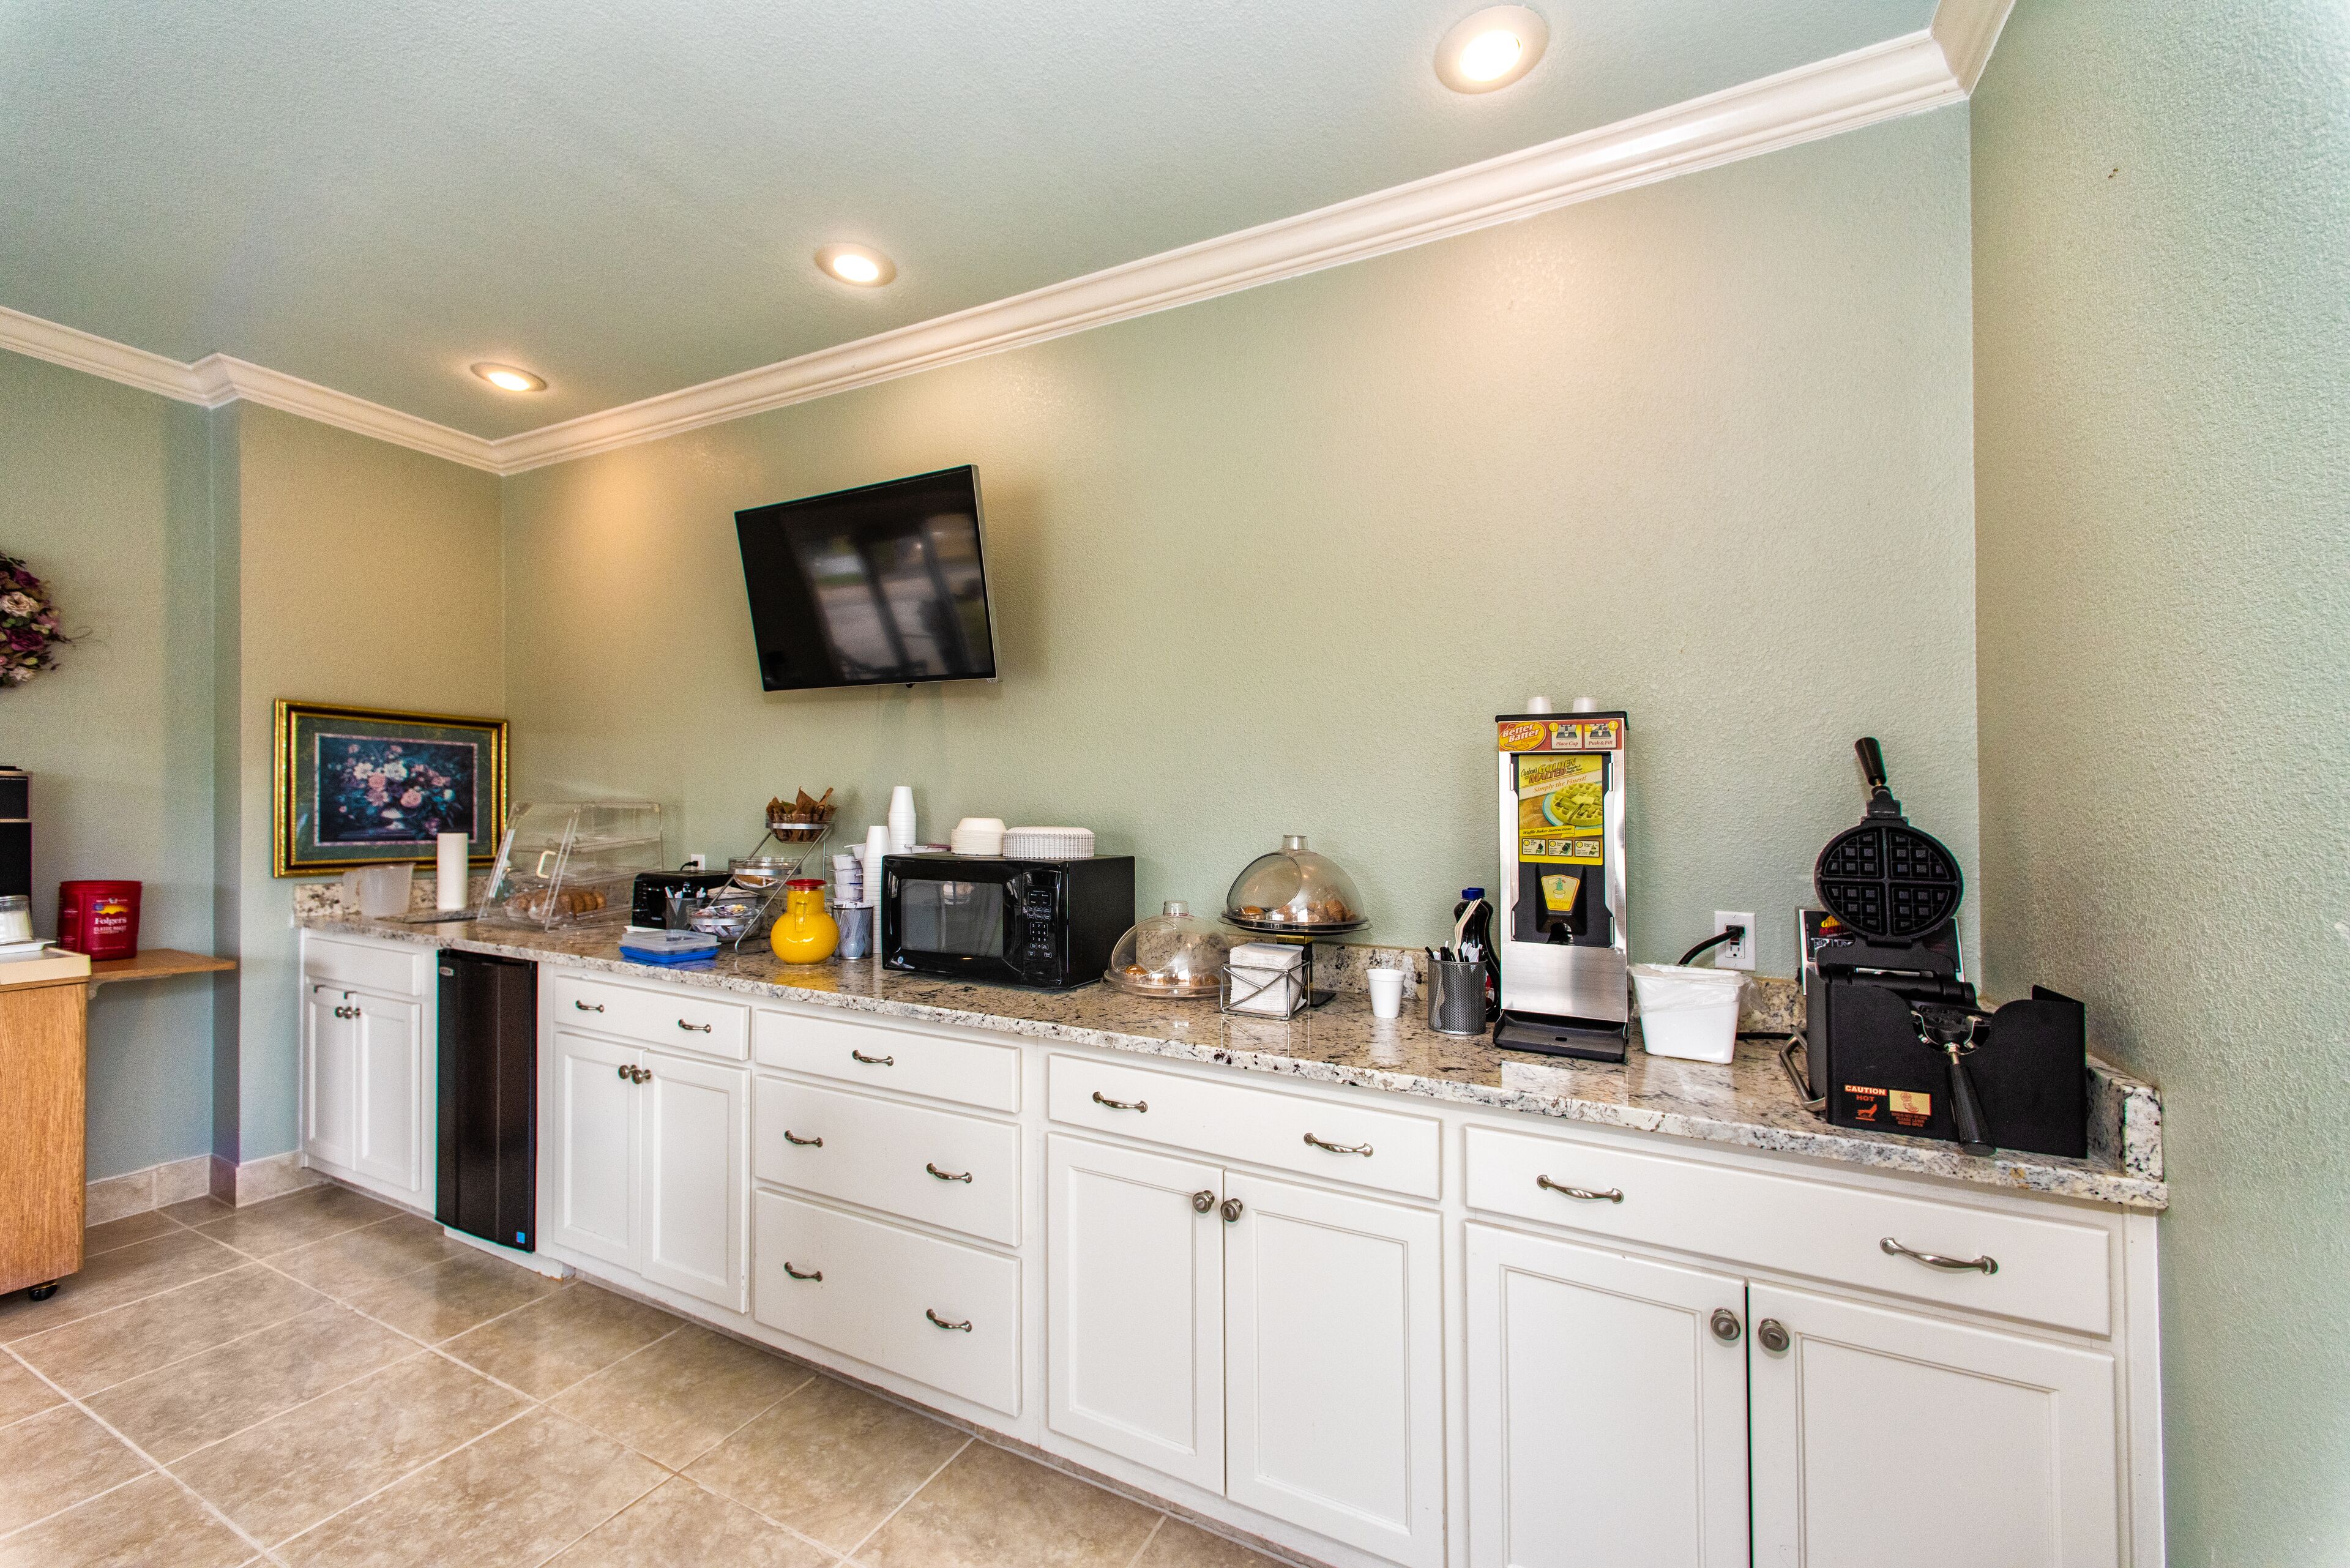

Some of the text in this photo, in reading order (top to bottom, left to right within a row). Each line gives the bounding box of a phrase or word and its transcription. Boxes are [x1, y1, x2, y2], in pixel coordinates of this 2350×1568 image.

[1502, 723, 1534, 737] Better
[1509, 729, 1540, 743] Batter
[1528, 768, 1567, 784] MALTED
[1533, 783, 1554, 793] Simply
[1567, 775, 1587, 785] Finest!
[95, 917, 127, 926] Folgers
[1845, 1085, 1886, 1095] CAUTION
